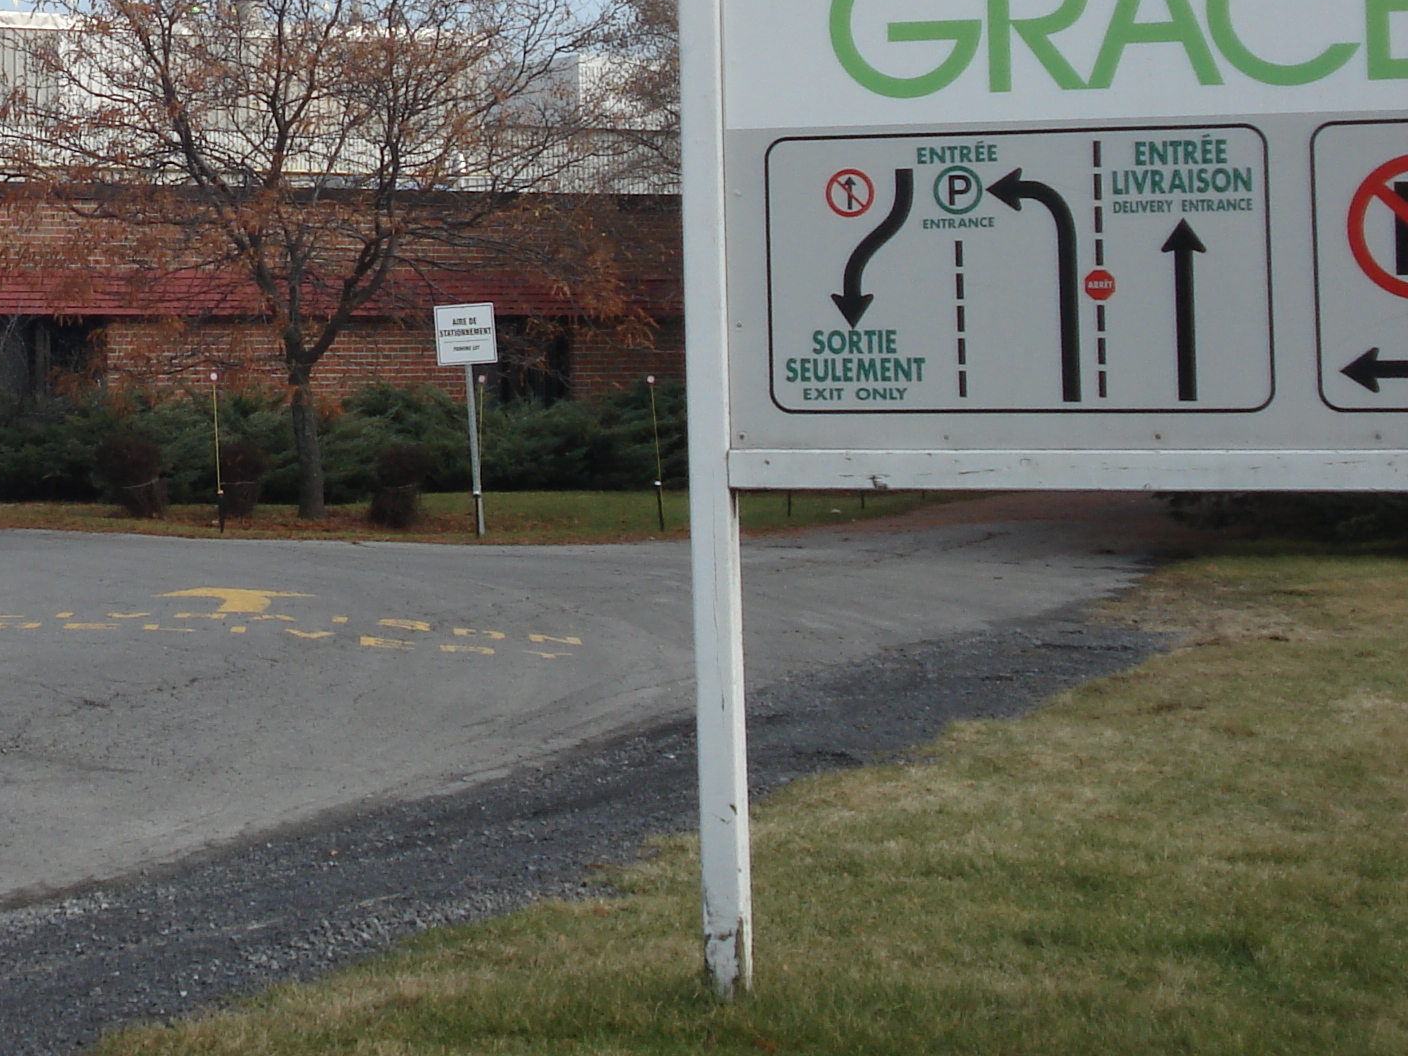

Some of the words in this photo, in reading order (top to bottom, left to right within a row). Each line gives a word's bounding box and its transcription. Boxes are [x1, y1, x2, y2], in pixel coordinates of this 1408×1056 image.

[916, 141, 998, 164] ENTRÉE
[1134, 134, 1228, 166] ENTRÉE
[948, 174, 972, 206] P
[1112, 167, 1253, 195] LIVRAISON
[1113, 200, 1173, 214] DELIVERY
[1181, 198, 1253, 212] ENTRANCE
[923, 217, 995, 229] ENTRANCE
[468, 317, 477, 325] DE
[813, 330, 897, 354] SORTIE
[785, 357, 926, 383] SEULEMENT
[803, 388, 845, 401] EXIT
[855, 387, 908, 401] ONLY
